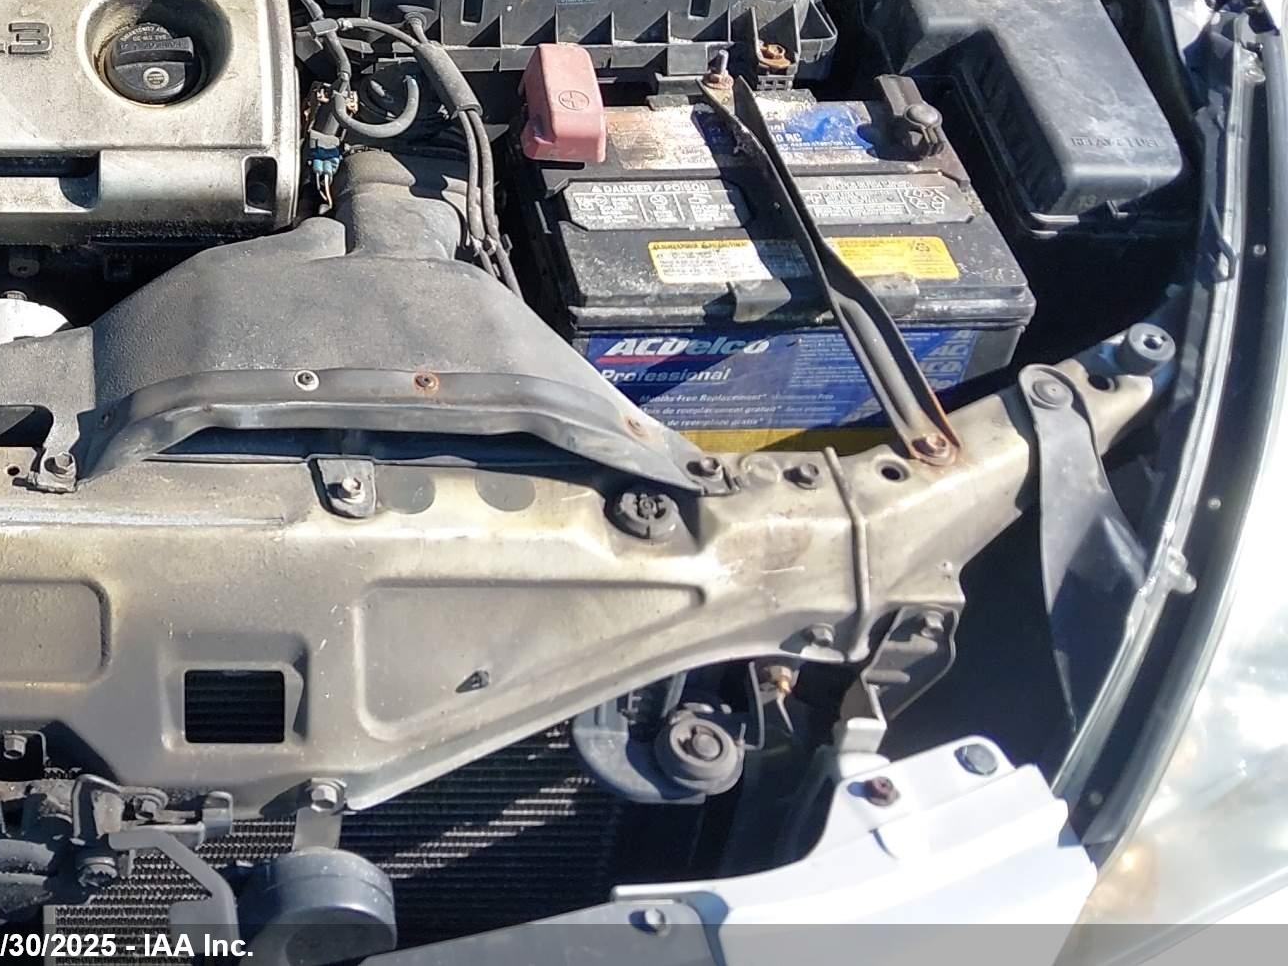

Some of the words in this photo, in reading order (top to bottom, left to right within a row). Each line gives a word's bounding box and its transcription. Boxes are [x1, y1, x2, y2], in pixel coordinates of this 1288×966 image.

[603, 184, 652, 193] DANGER
[663, 183, 710, 193] POISON
[604, 336, 771, 356] ACDelco
[599, 368, 732, 383] Professional
